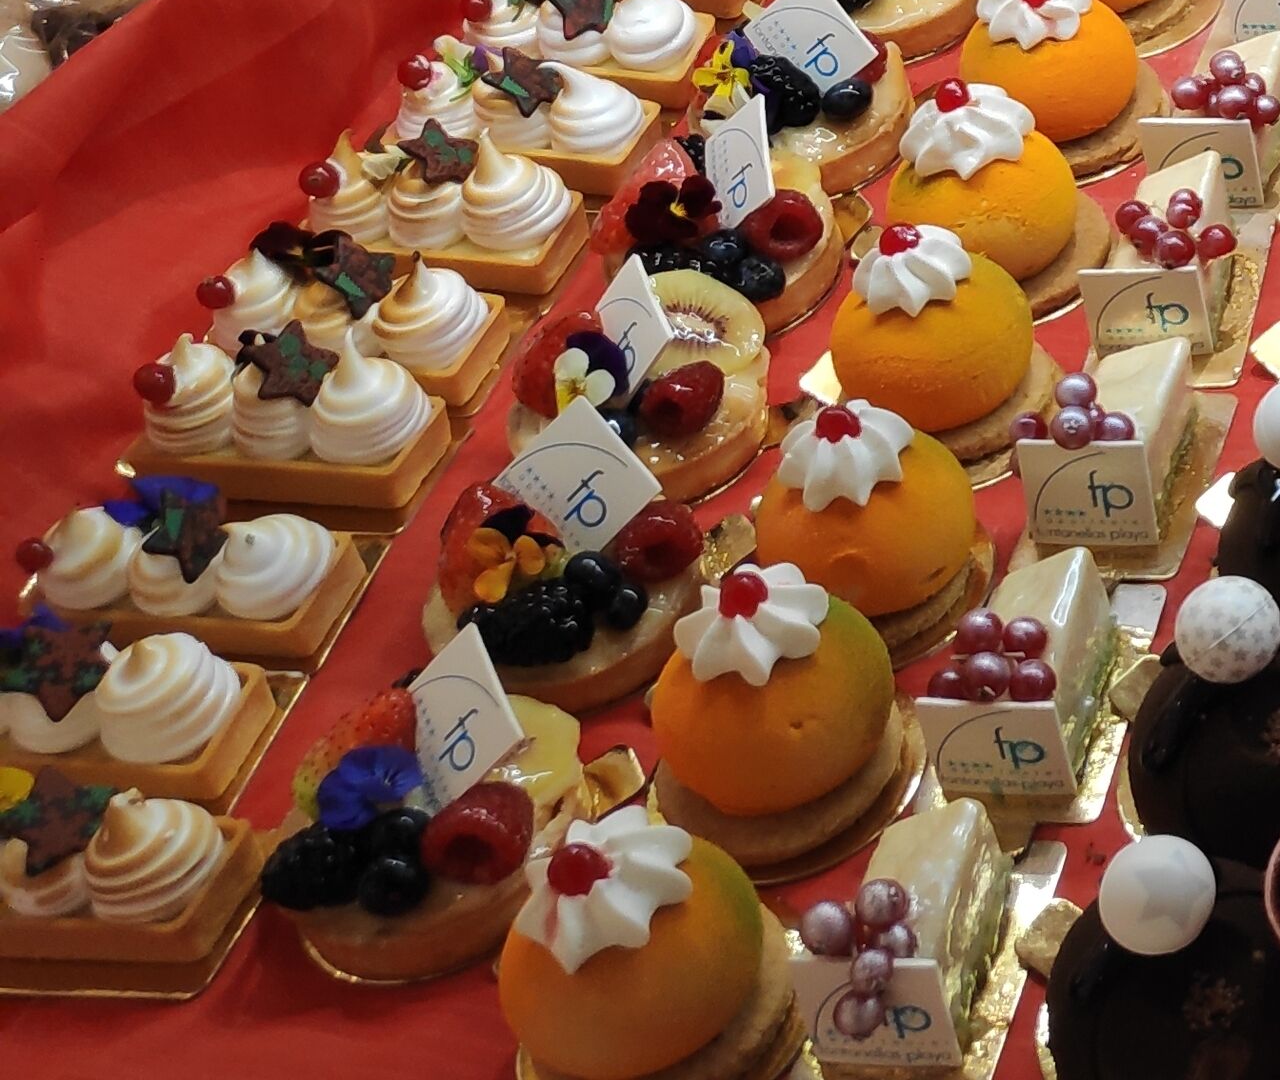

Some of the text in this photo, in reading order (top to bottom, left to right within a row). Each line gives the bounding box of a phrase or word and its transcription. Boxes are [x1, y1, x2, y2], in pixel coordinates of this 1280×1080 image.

[804, 33, 838, 76] fp
[727, 163, 753, 208] fp
[1146, 292, 1189, 333] fp
[564, 469, 607, 528] fp
[1088, 469, 1134, 517] fp
[439, 708, 478, 771] fp
[994, 726, 1045, 769] fp
[884, 1004, 932, 1039] p
